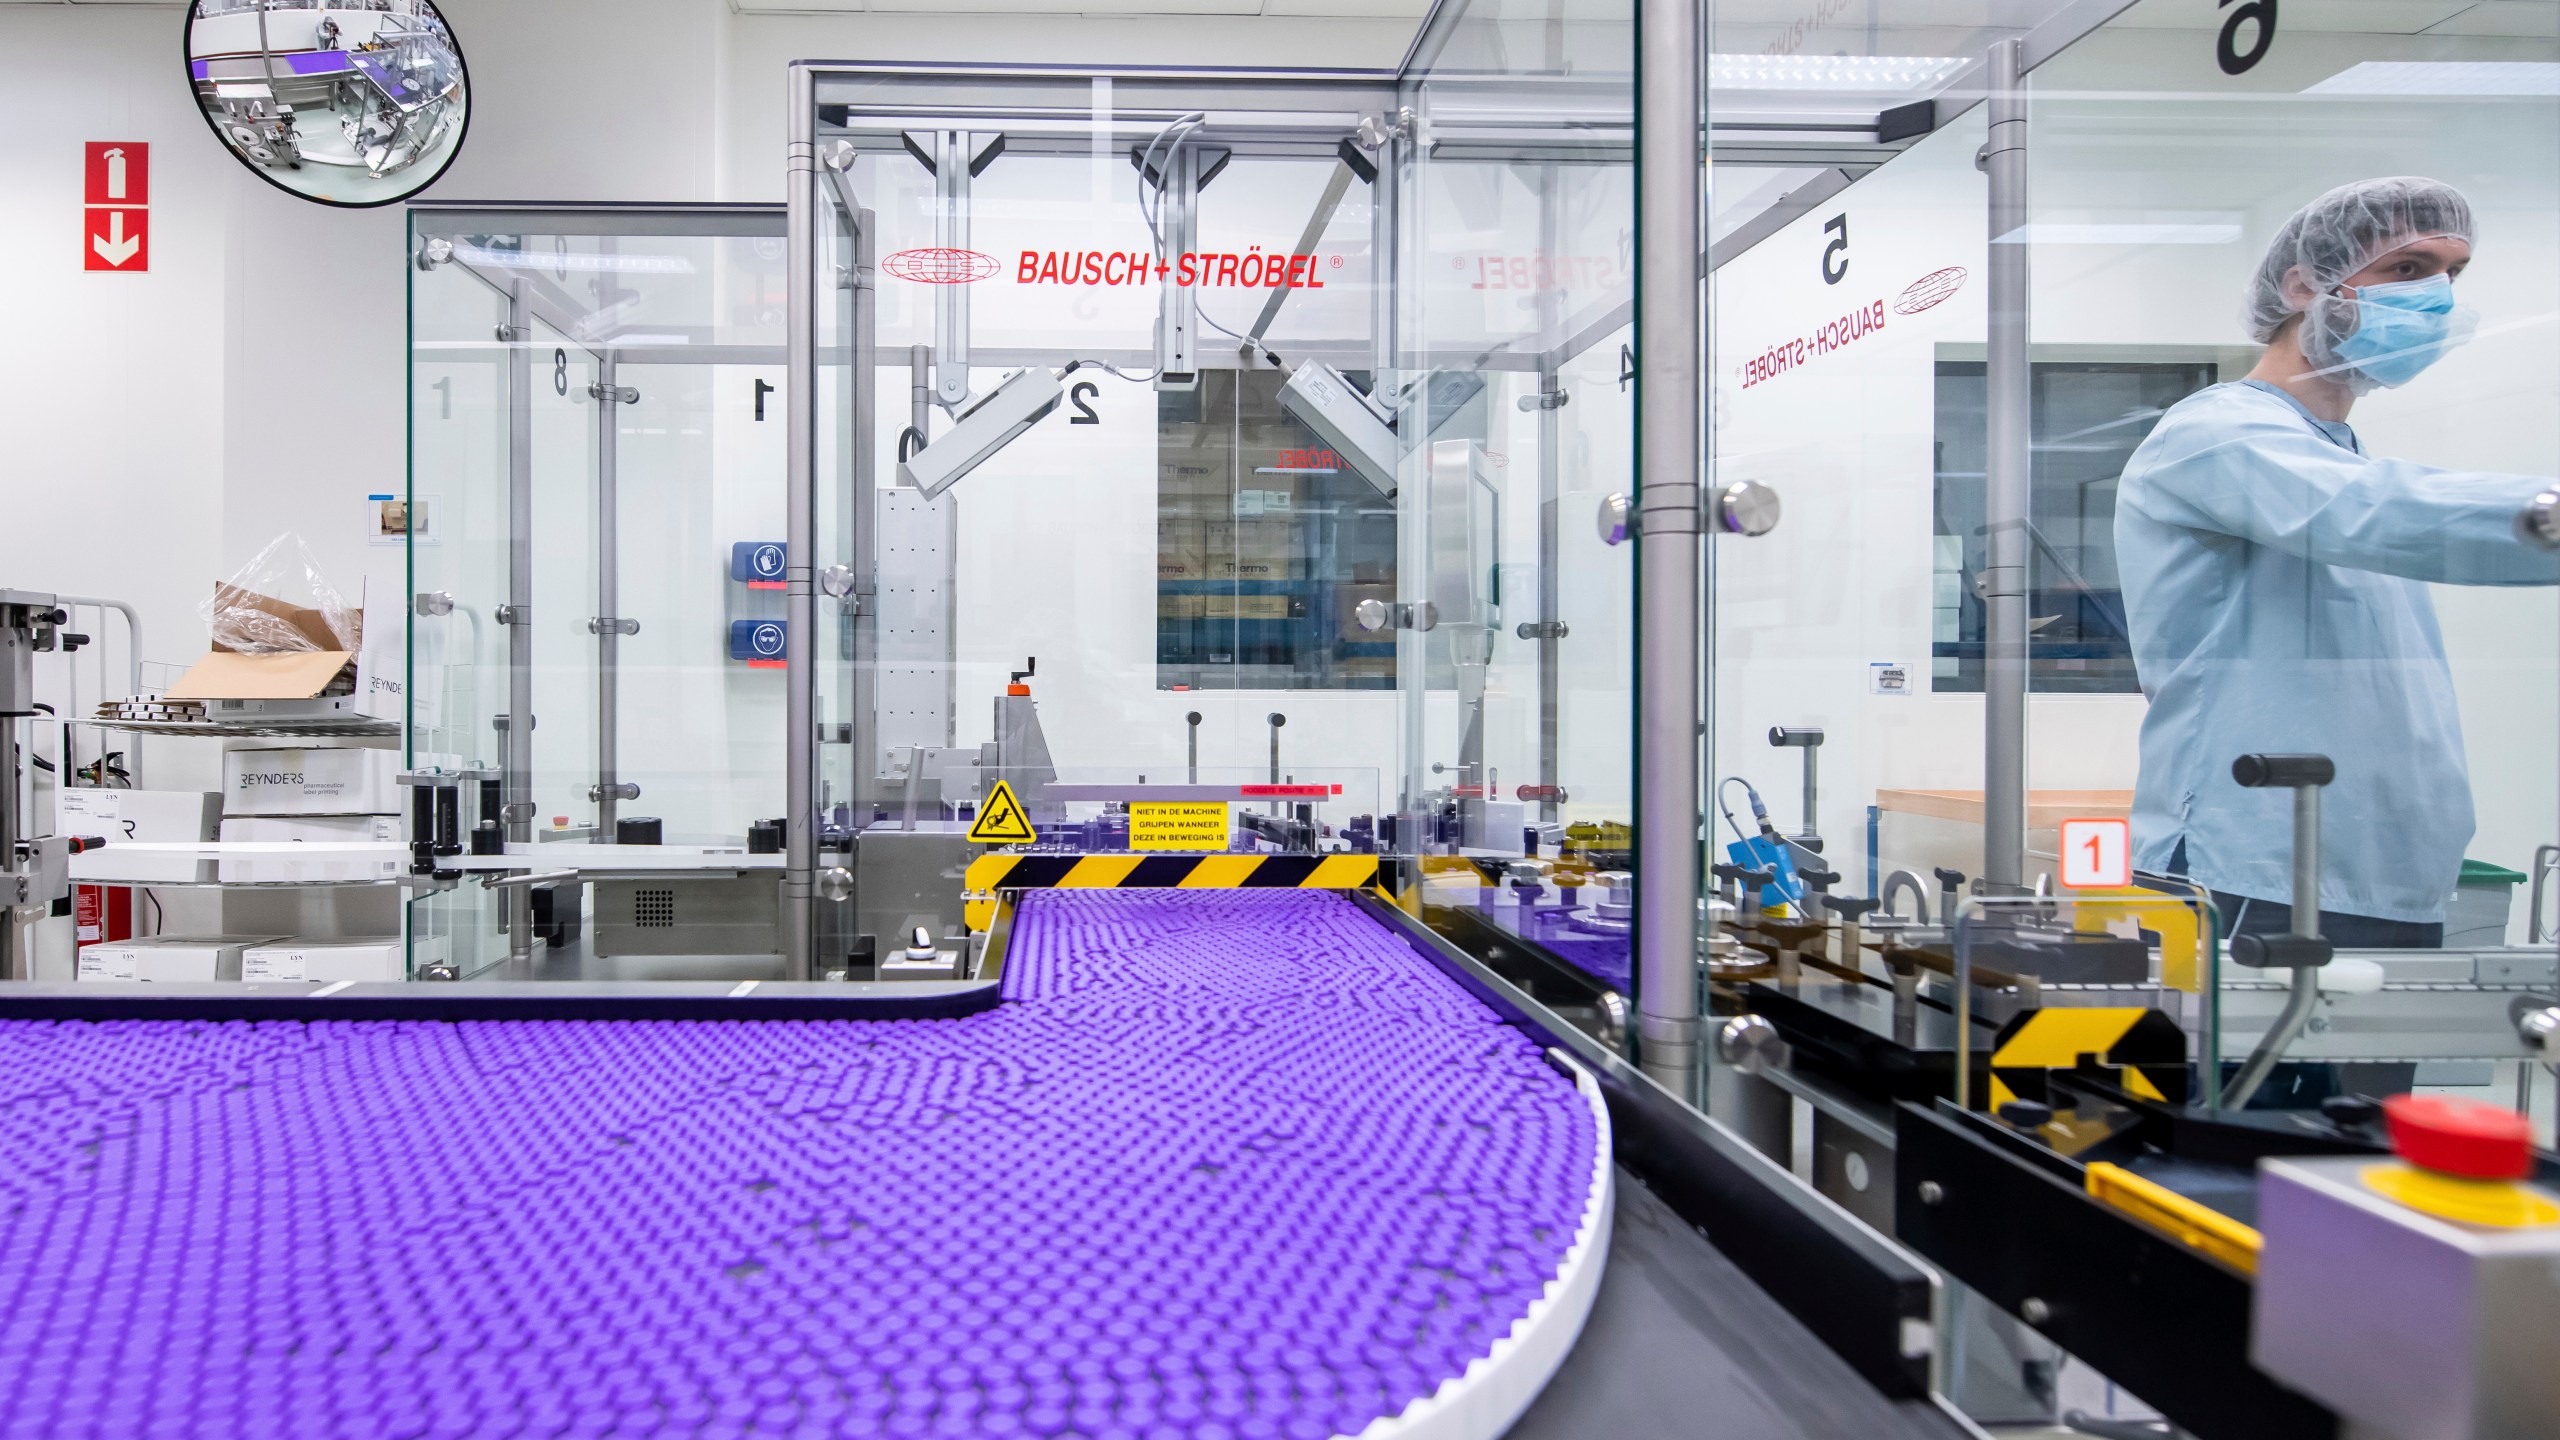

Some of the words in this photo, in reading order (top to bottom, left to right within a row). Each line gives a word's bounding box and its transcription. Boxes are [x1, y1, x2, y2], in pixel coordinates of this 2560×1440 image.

[240, 773, 304, 785] REYNDERS
[1136, 808, 1155, 816] NIET
[1157, 808, 1167, 816] IN
[1169, 808, 1181, 816] DE
[1183, 808, 1222, 816] MACHINE
[122, 820, 136, 840] R
[2083, 834, 2100, 873] 1
